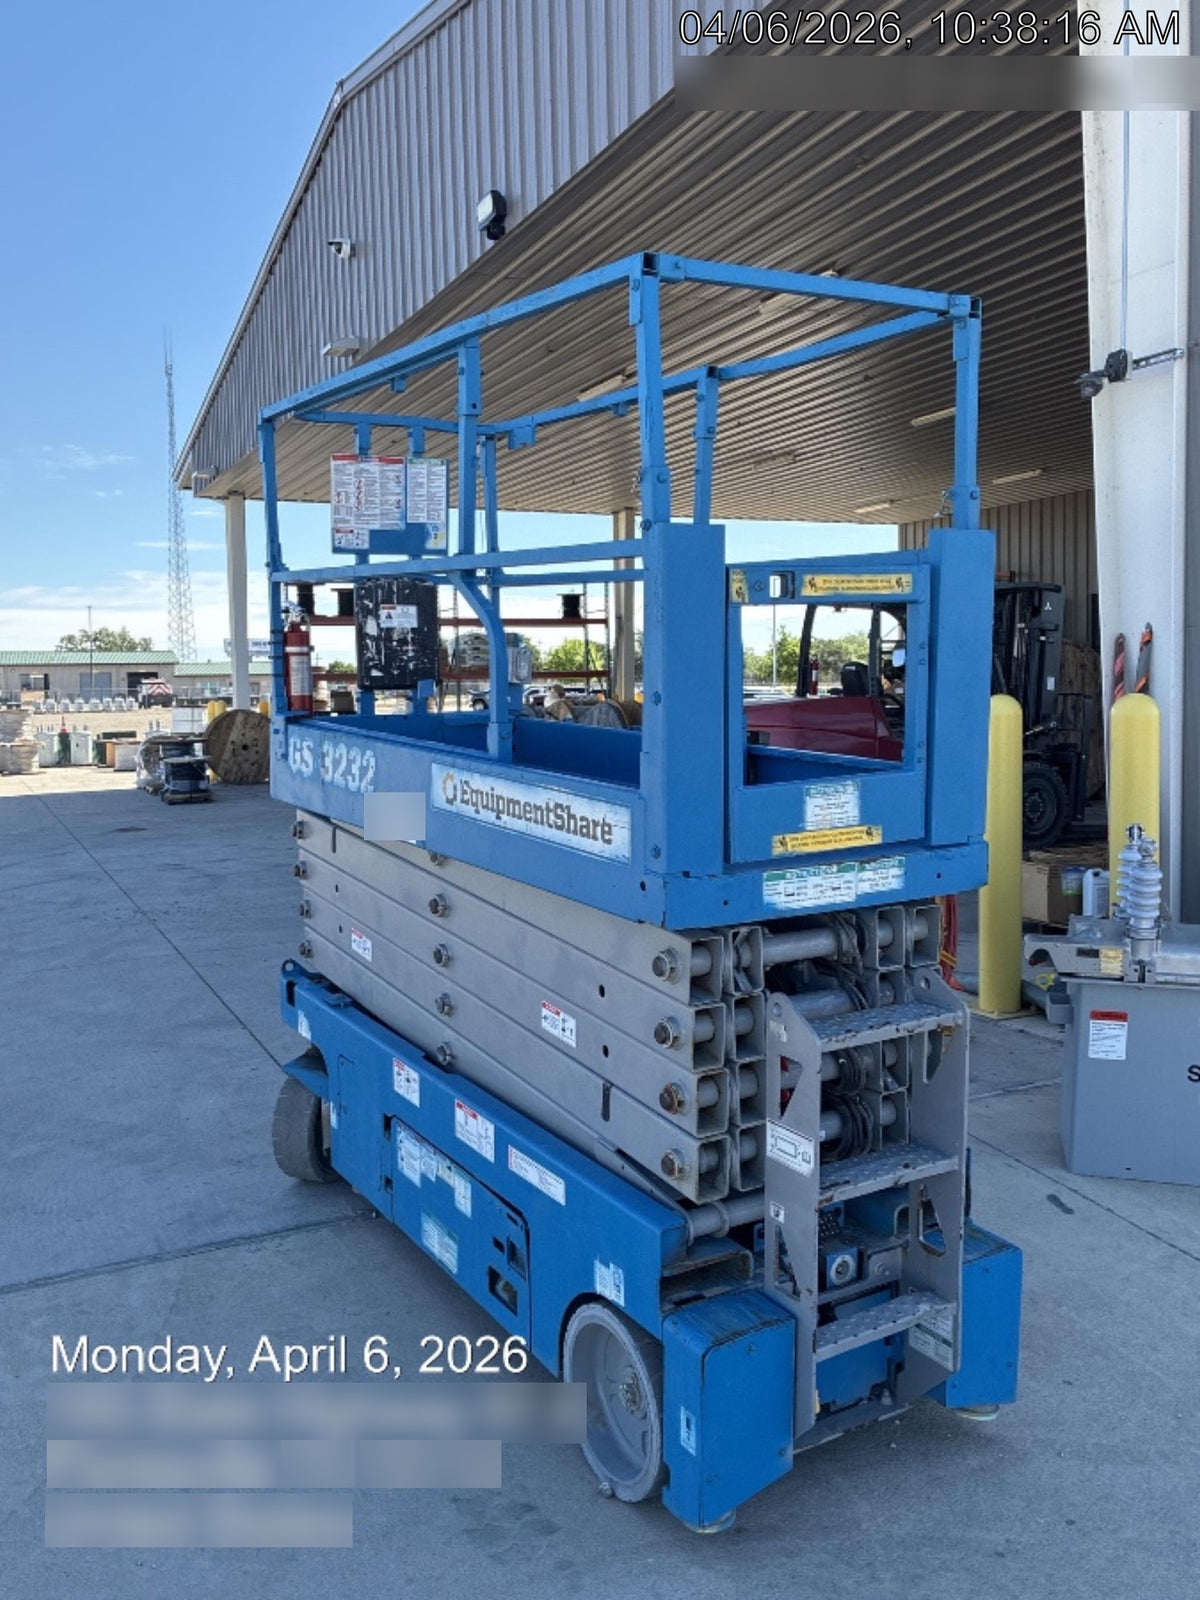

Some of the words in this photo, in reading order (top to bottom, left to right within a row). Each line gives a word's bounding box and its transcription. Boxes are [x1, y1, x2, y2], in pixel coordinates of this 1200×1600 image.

[288, 736, 314, 778] GS
[322, 740, 376, 792] 3232
[459, 779, 613, 845] EquipmentShare
